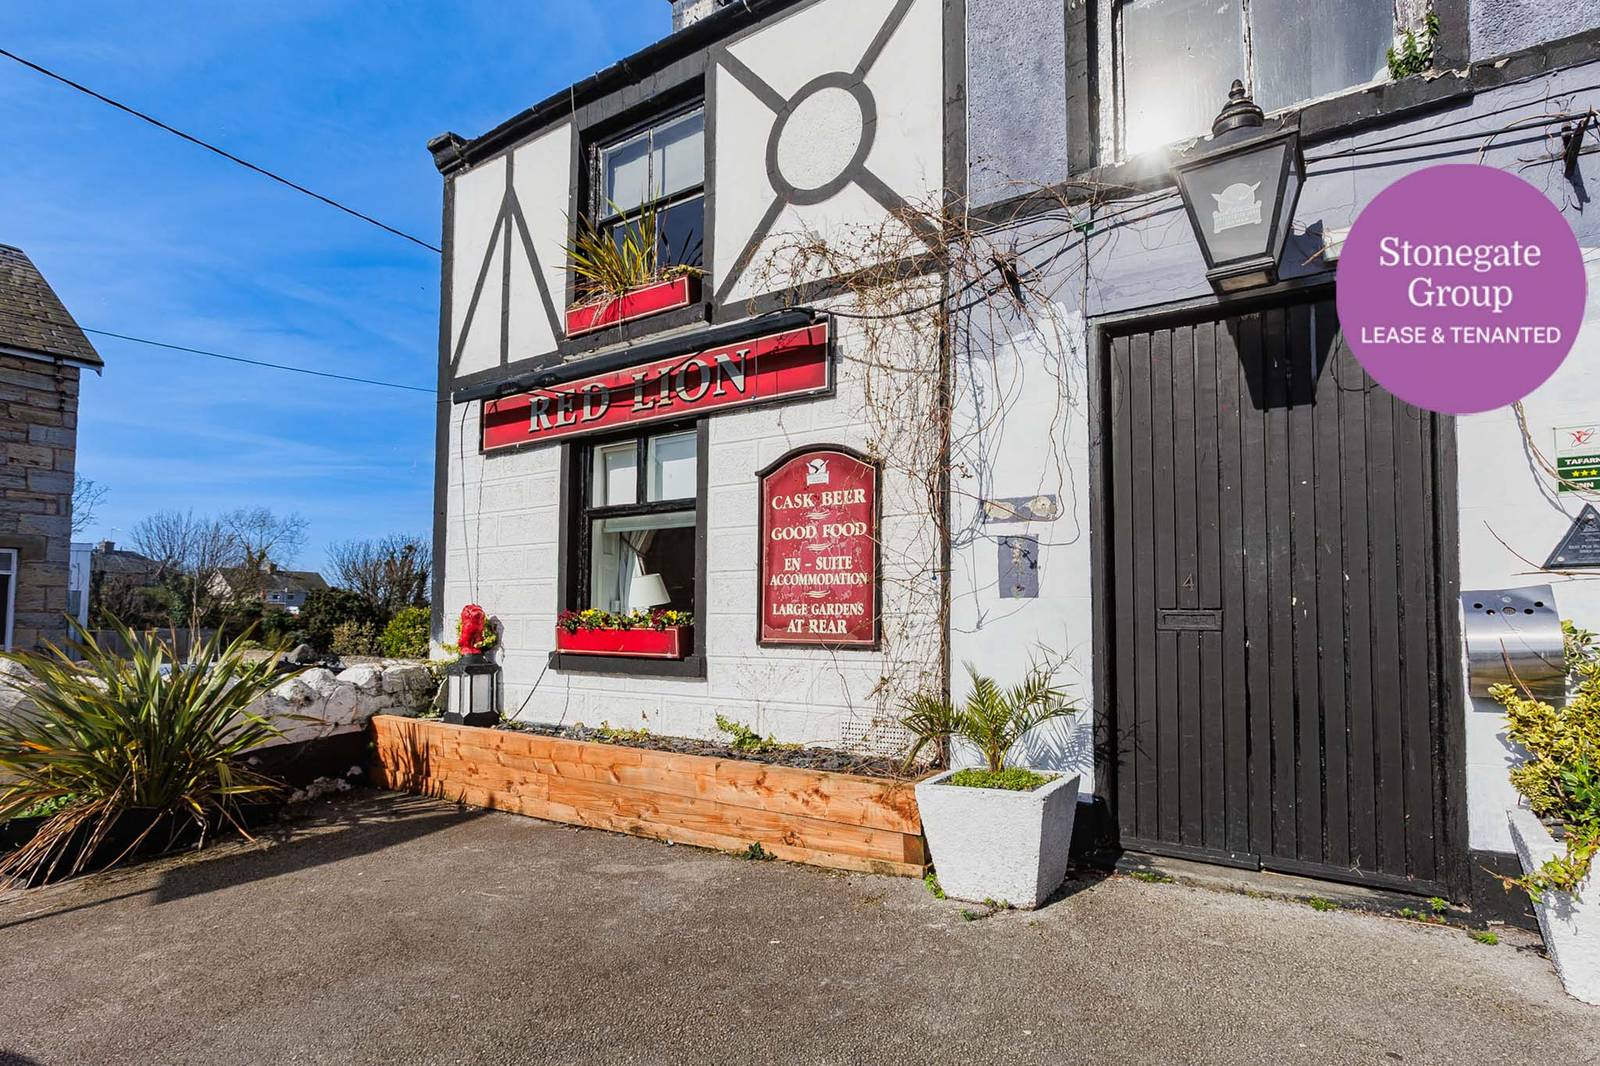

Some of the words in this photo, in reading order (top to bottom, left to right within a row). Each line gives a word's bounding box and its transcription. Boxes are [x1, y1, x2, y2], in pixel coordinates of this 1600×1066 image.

[528, 382, 609, 432] RED
[632, 349, 749, 412] LION
[771, 495, 814, 509] CASK
[821, 488, 866, 507] BEER
[771, 526, 817, 540] GOOD
[822, 522, 867, 538] FOOD
[784, 557, 800, 572] EN
[815, 556, 853, 571] SUITE
[769, 572, 868, 587] ACCOMMODATION
[772, 603, 808, 616] LARGE
[811, 602, 864, 616] GARDENS
[787, 619, 804, 634] AT
[809, 619, 848, 634] REAR
